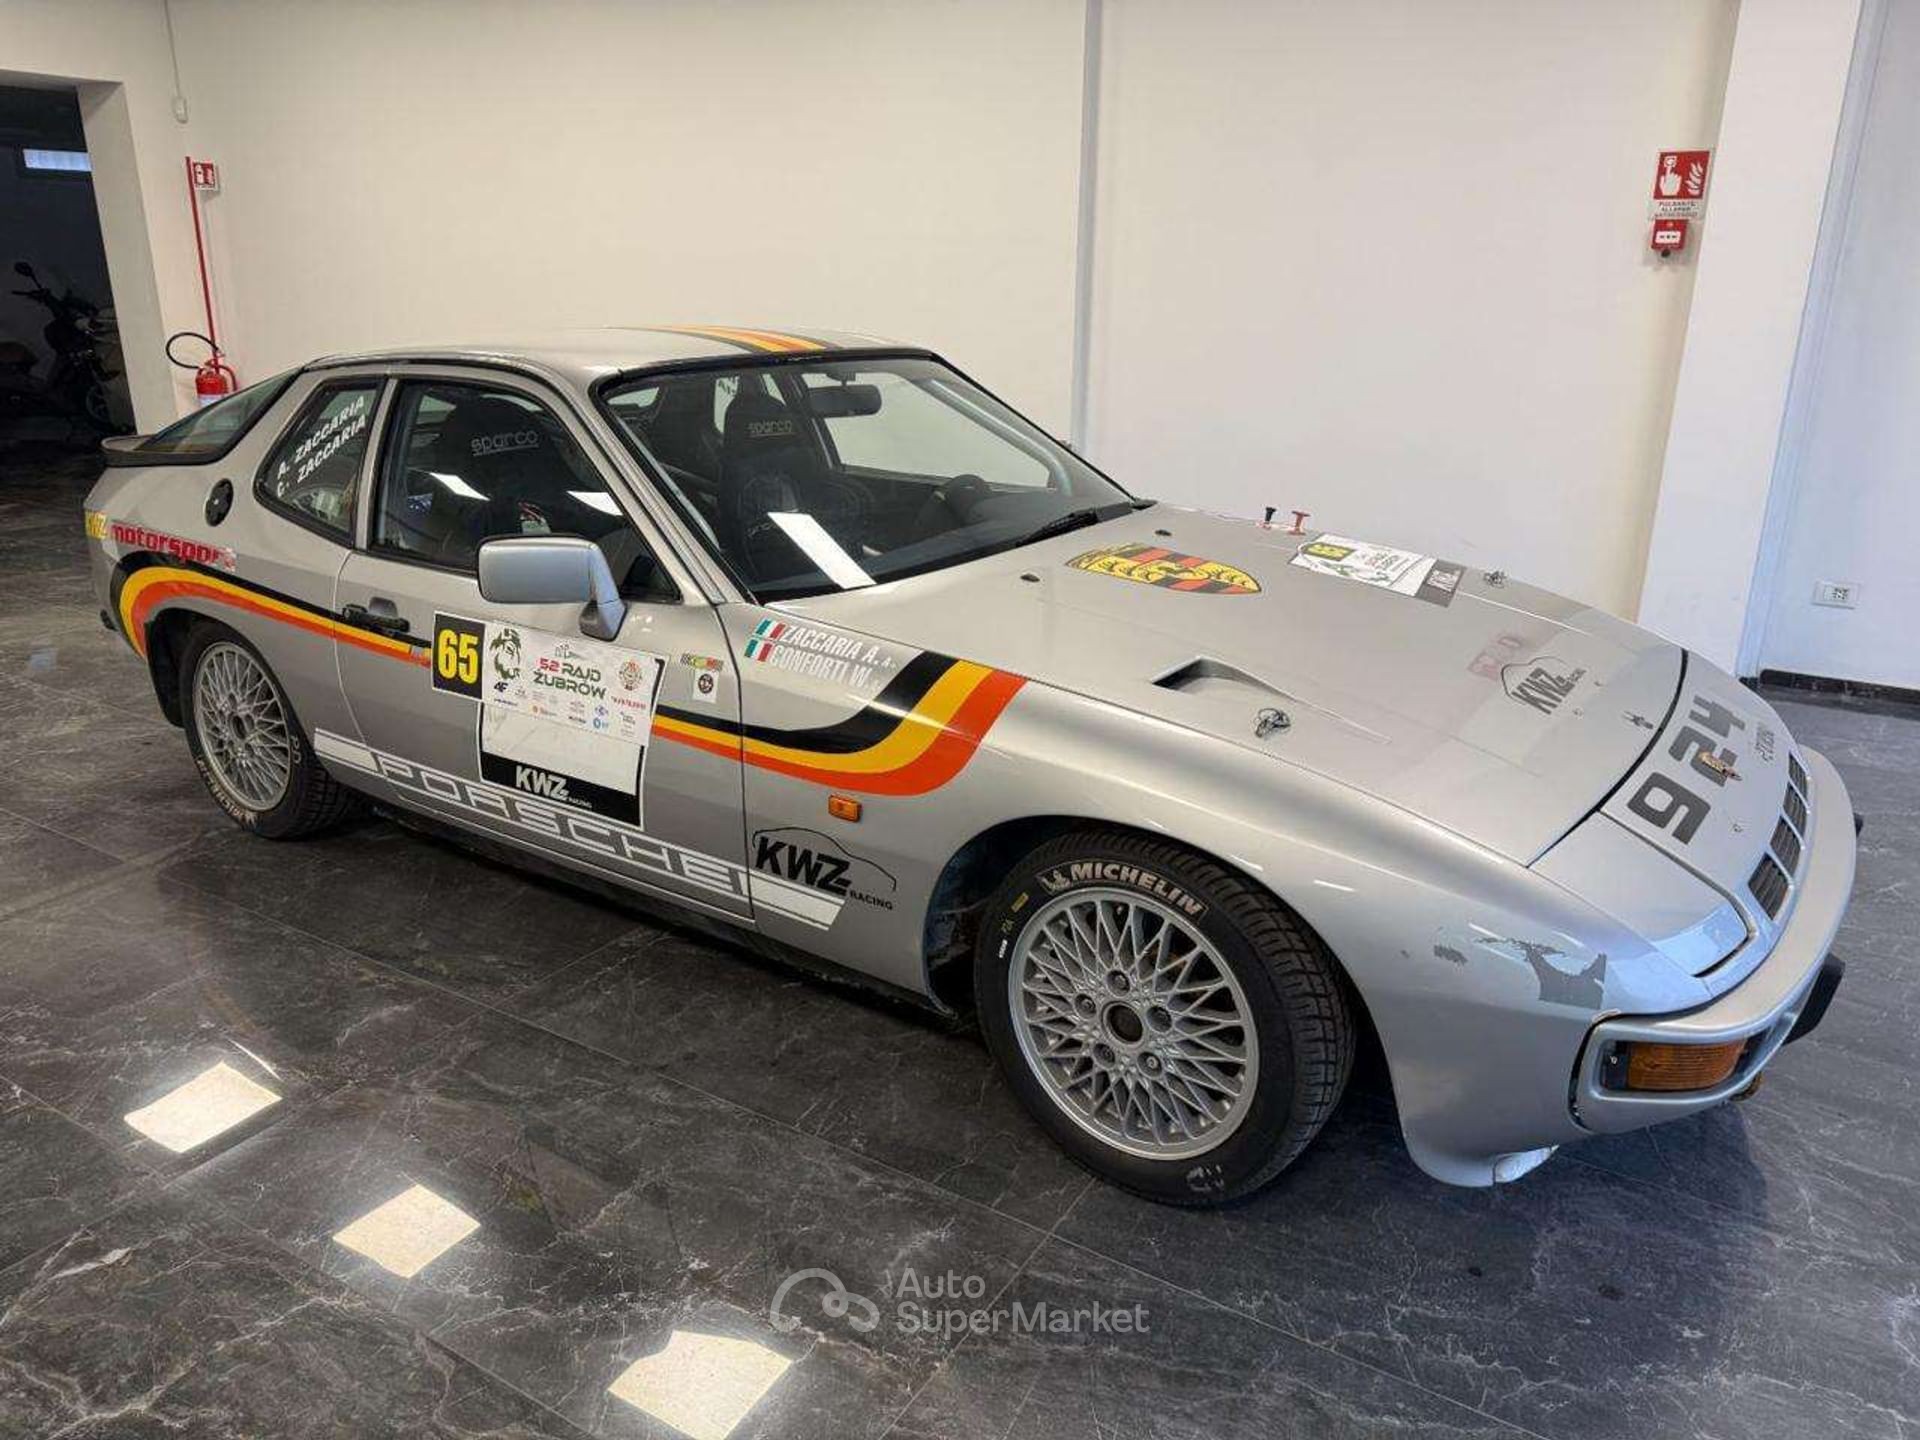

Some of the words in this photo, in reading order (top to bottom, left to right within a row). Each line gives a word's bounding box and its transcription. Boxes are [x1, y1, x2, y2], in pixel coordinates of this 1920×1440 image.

[294, 396, 364, 464] ZACCARIA
[297, 414, 366, 483] ZACCARIA
[471, 430, 539, 457] sparco
[110, 523, 236, 572] motorspor
[437, 628, 479, 685] 65
[780, 625, 862, 660] ZACCARIA
[533, 669, 607, 699] ŻUBRÓW
[538, 657, 561, 673] 52
[561, 662, 602, 683] RAJD
[1511, 667, 1575, 714] KWZ
[515, 764, 569, 801] KWZ
[1626, 694, 1746, 845] 924
[377, 757, 735, 894] PORSCHE
[755, 836, 852, 896] KWZ
[850, 889, 893, 910] RACING
[1069, 861, 1204, 917] MICHELIN
